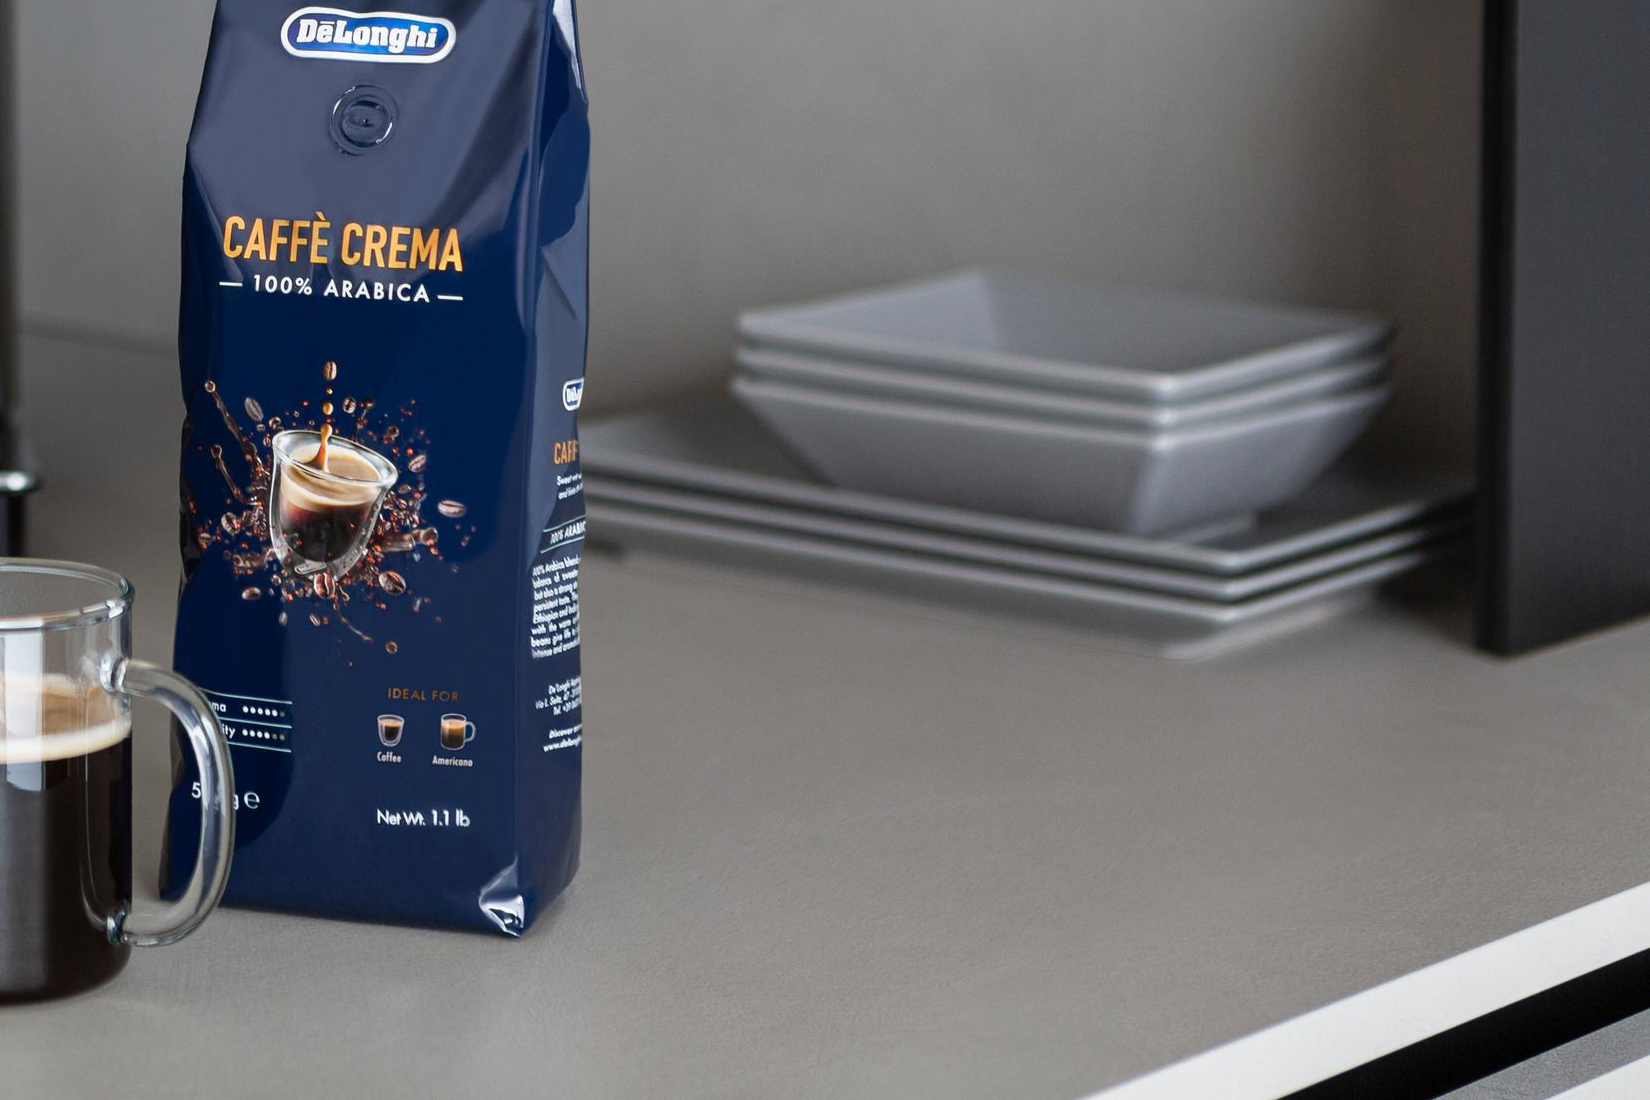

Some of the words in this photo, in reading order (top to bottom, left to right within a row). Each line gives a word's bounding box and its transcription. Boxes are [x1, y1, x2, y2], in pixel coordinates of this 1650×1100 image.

[223, 211, 331, 266] CAFFÈ
[340, 221, 463, 273] CREMA
[253, 273, 313, 297] 100%
[323, 278, 430, 304] ARABICA
[553, 439, 579, 466] CAFF
[387, 687, 427, 701] IDEAL
[431, 690, 460, 703] FOR
[376, 751, 402, 763] Coffee
[432, 755, 474, 768] Americano
[376, 807, 401, 826] Net
[431, 808, 450, 827] 1.1
[455, 808, 471, 828] lb
